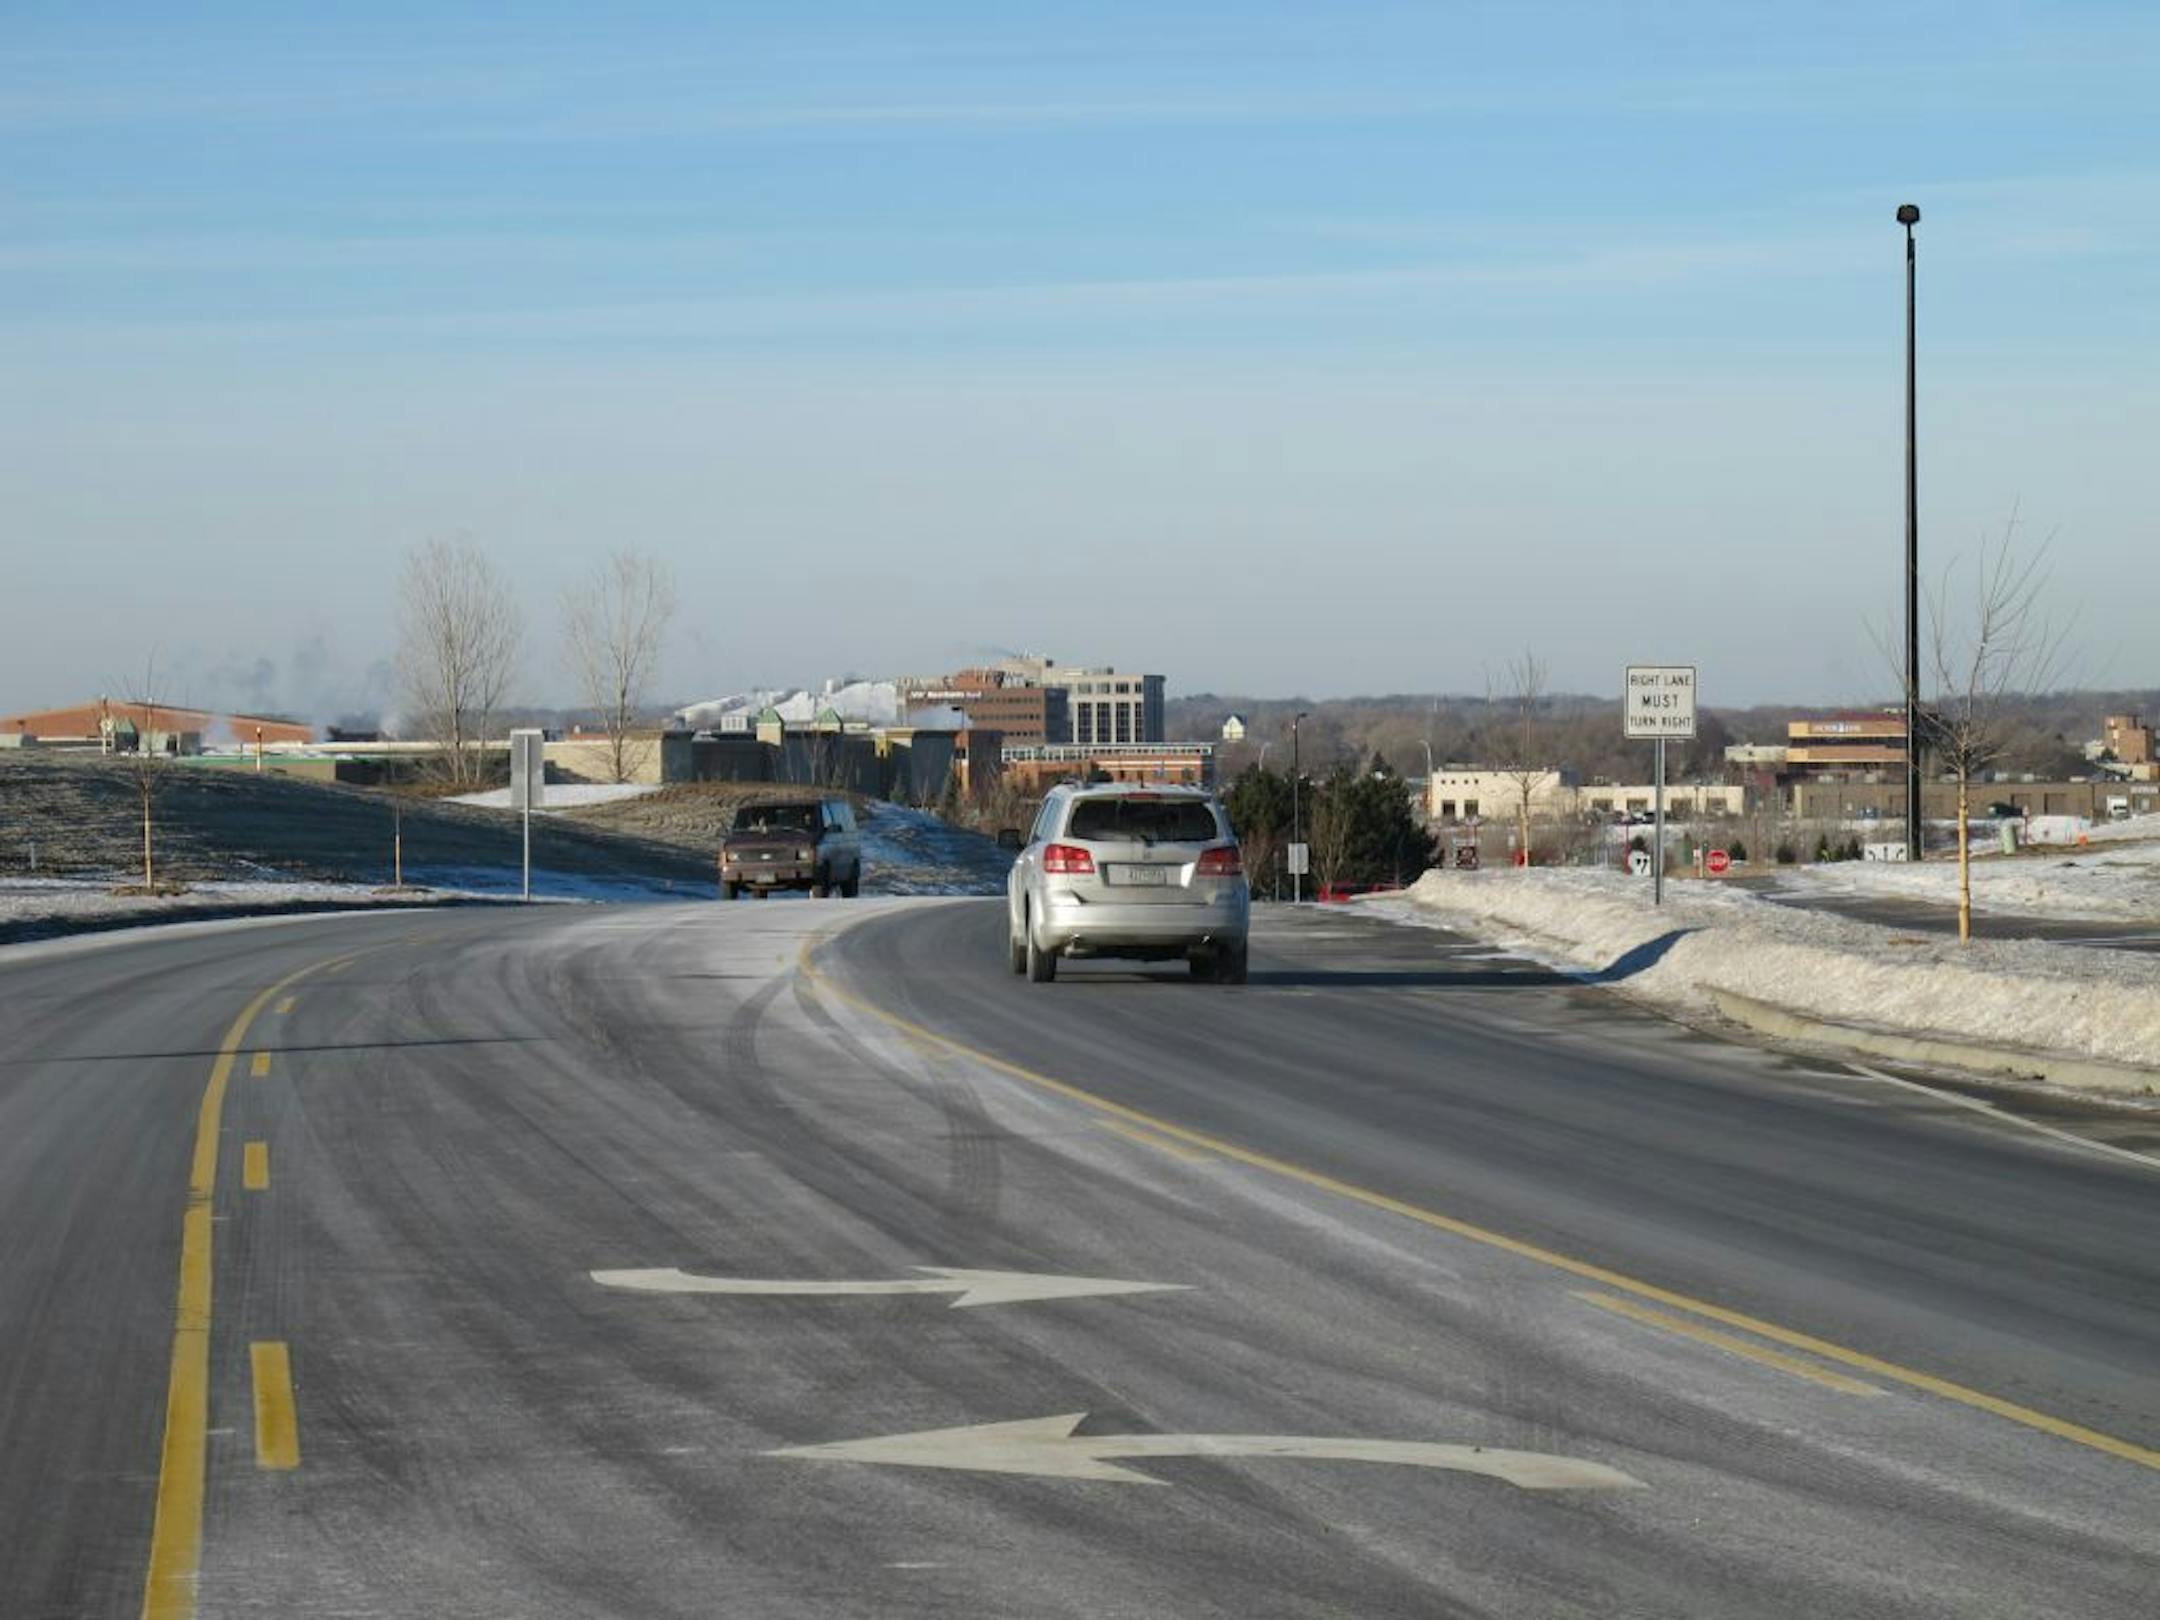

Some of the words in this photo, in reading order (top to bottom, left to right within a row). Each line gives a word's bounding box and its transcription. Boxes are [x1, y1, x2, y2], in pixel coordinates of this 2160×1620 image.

[1630, 675, 1660, 686] RIGHT
[1664, 675, 1691, 686] LANE
[1642, 695, 1679, 708] MUST
[1630, 716, 1656, 727] TURN
[1662, 716, 1691, 727] RIGHT
